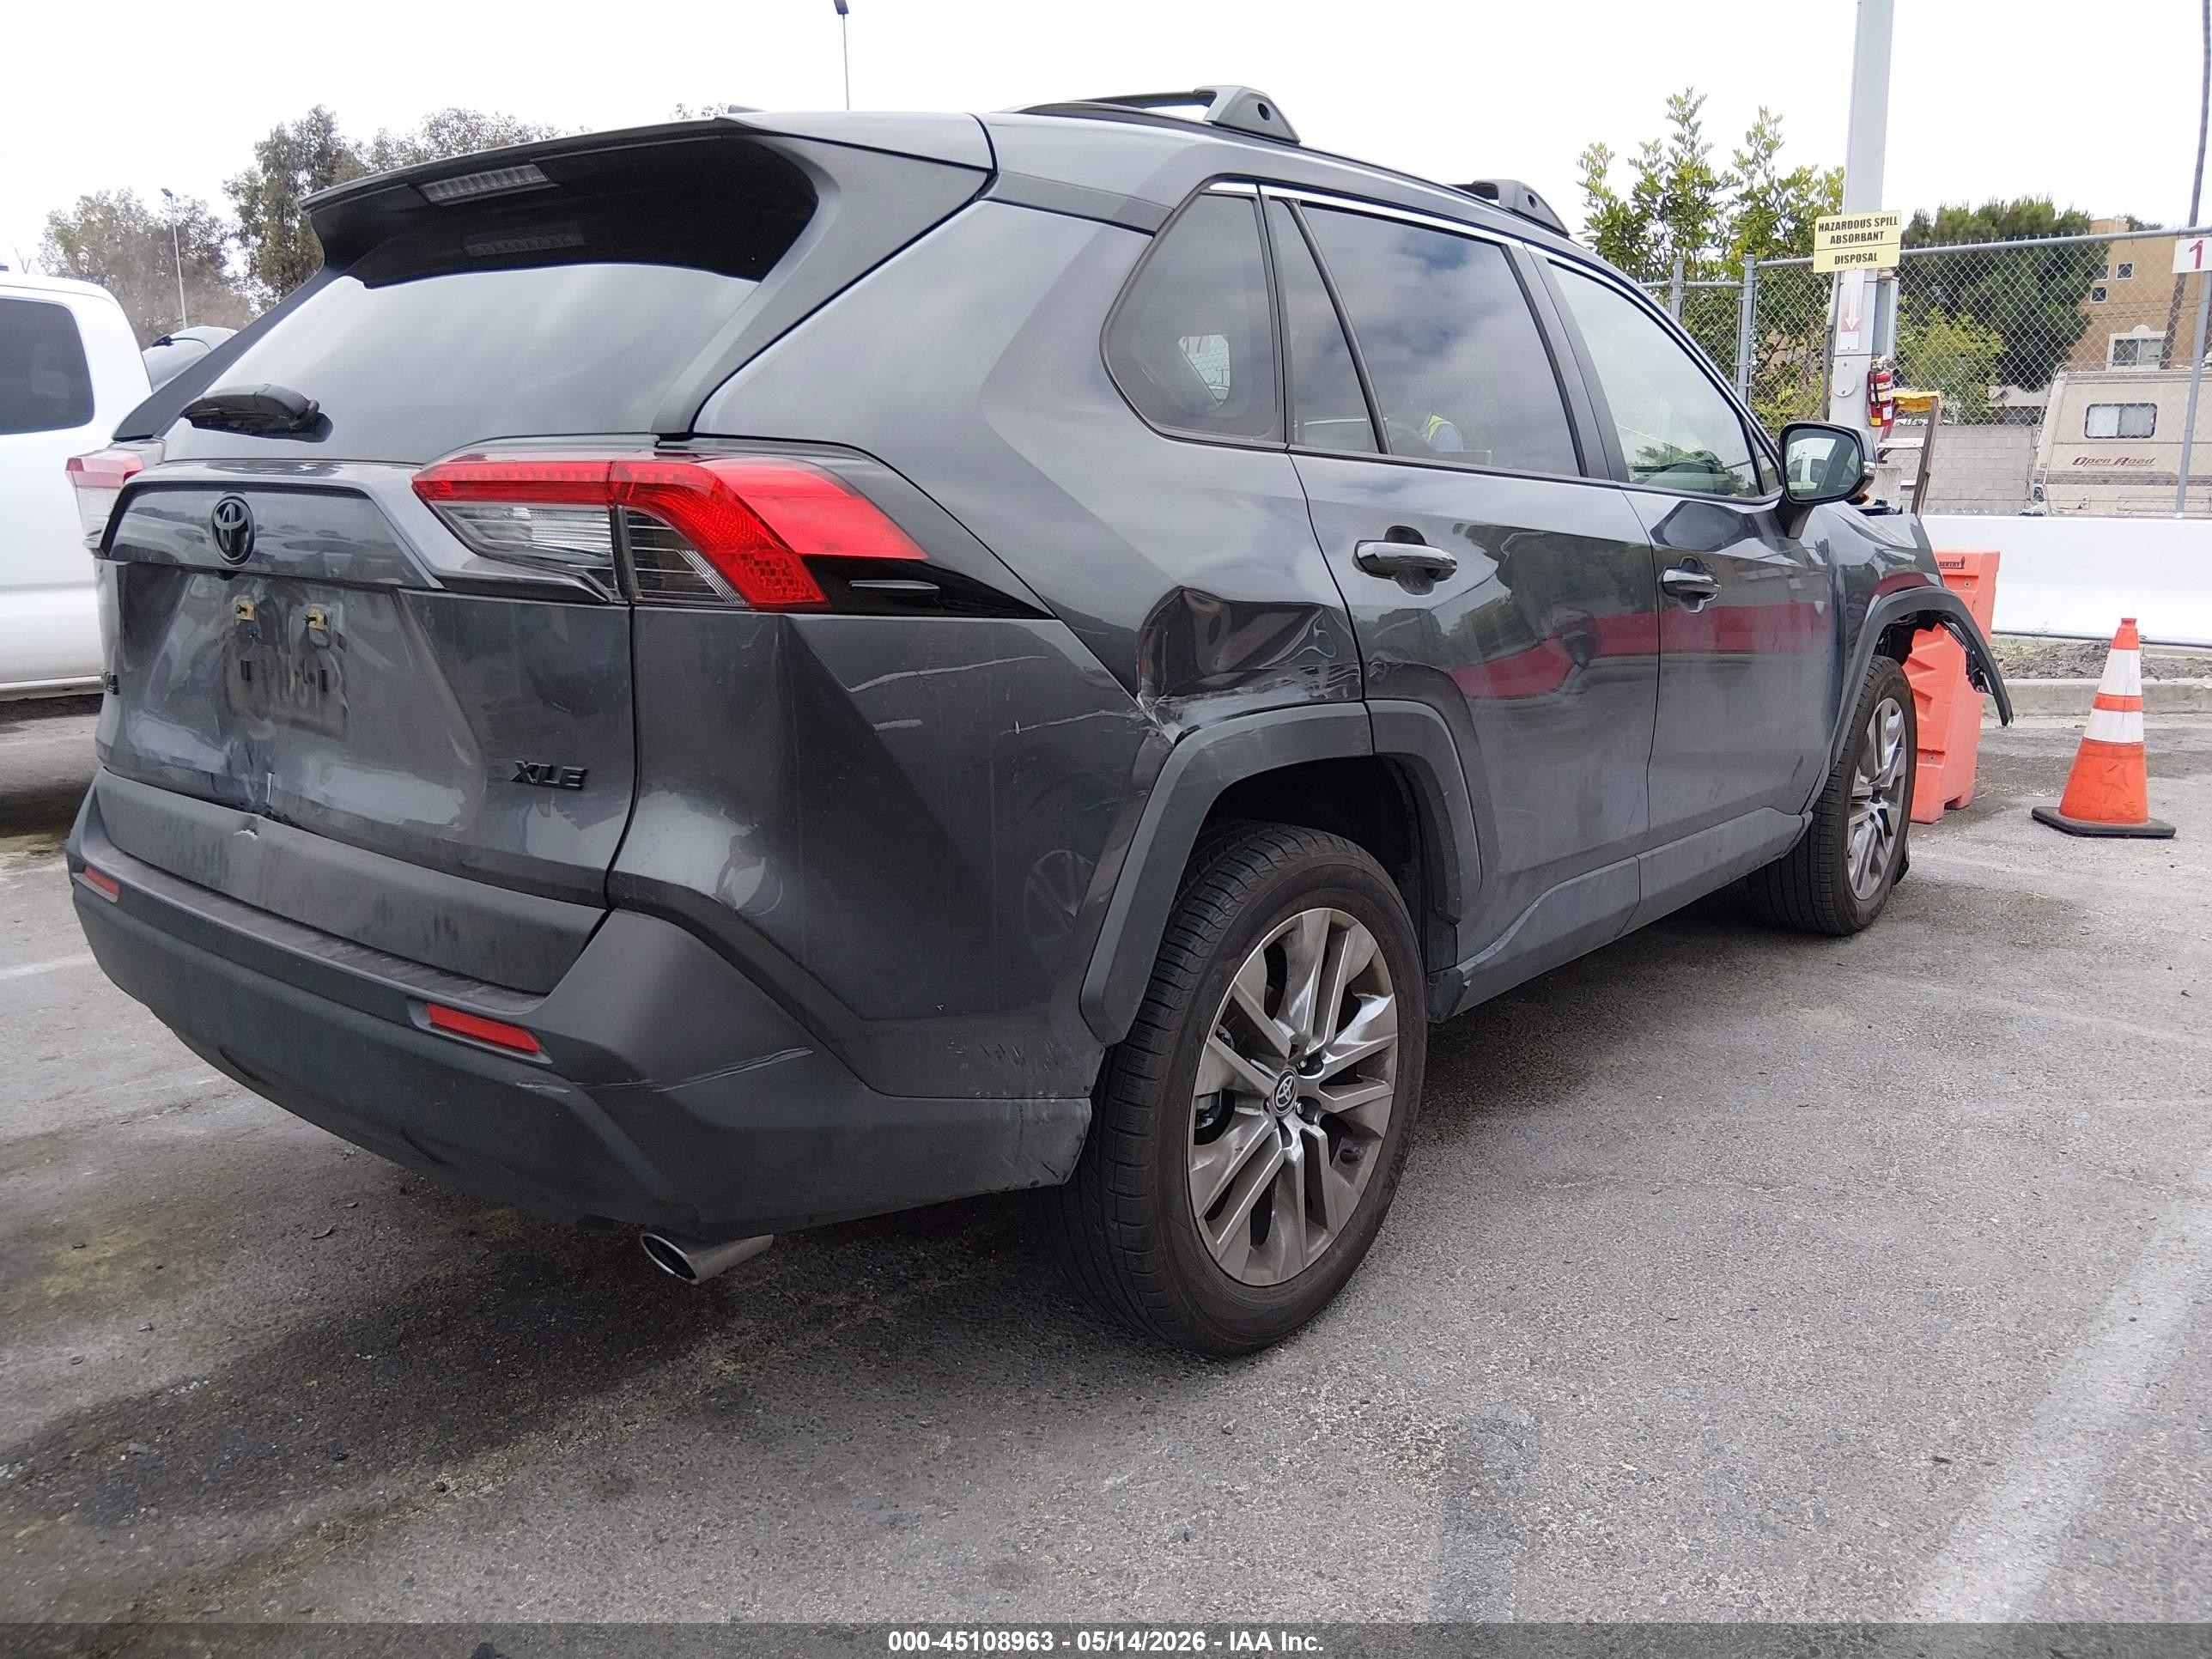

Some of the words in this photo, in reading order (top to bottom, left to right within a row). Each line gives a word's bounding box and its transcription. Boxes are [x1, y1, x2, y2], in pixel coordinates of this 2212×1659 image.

[1818, 218, 1872, 233] HAZARDOUS
[1874, 216, 1899, 228] SPILL
[1830, 231, 1884, 245] ABSORBANT
[1834, 252, 1878, 265] DISPOSAL
[2189, 240, 2203, 270] 1
[2071, 456, 2112, 467] Open
[2113, 456, 2156, 466] Road
[509, 760, 588, 791] XLE
